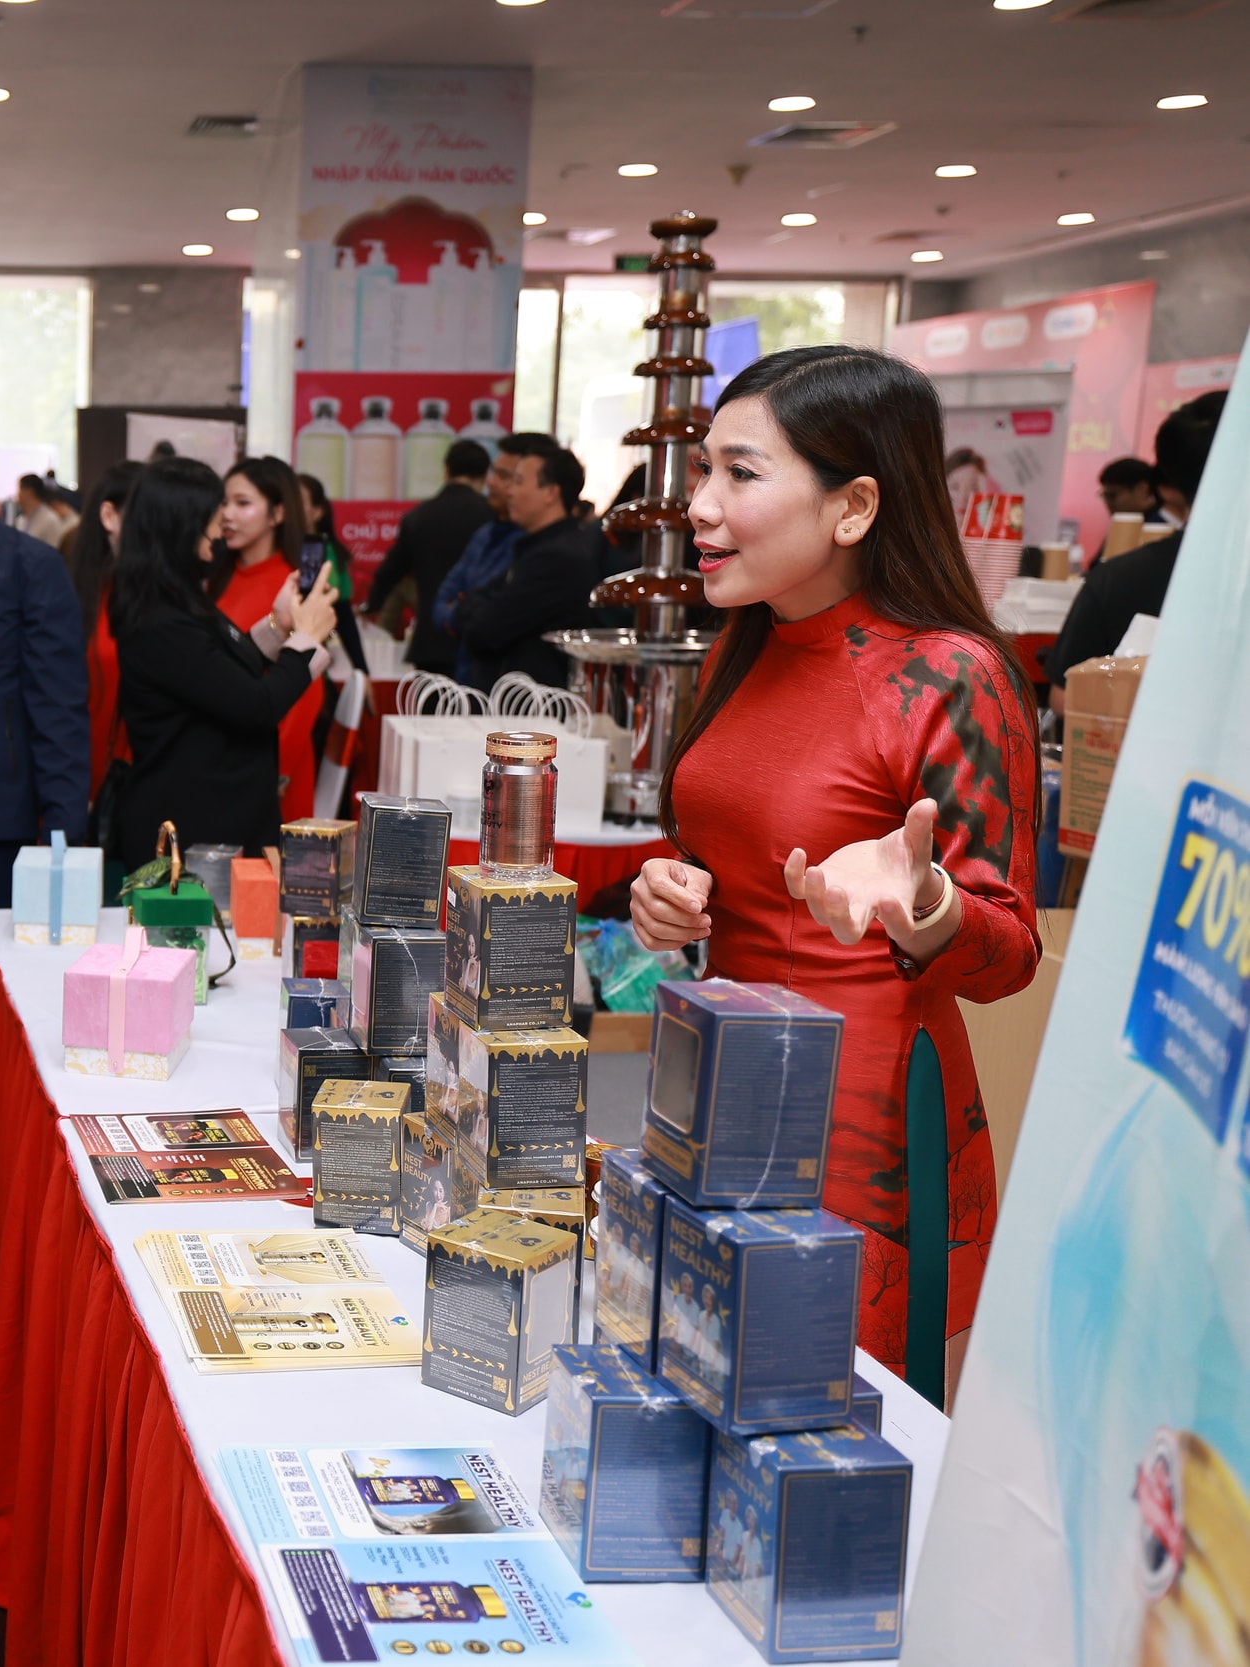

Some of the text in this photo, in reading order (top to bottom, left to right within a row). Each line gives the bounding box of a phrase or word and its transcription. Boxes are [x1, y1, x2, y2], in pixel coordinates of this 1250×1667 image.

[447, 924, 467, 939] BEAUTY
[245, 1170, 268, 1190] STRONG
[404, 1164, 432, 1184] BEAUTY
[405, 1153, 422, 1168] NEST
[605, 1191, 653, 1237] HEALTHY
[671, 1216, 704, 1249] NEST
[326, 1239, 360, 1279] NEST BEAUTY
[670, 1239, 731, 1289] HEALTHY
[341, 1298, 379, 1346] NEST BEAUTY
[523, 1366, 540, 1383] NEST
[465, 1454, 523, 1528] NEST HEALTHY
[717, 1453, 773, 1513] HEALTHY
[495, 1559, 556, 1644] NEST HEALTHY
